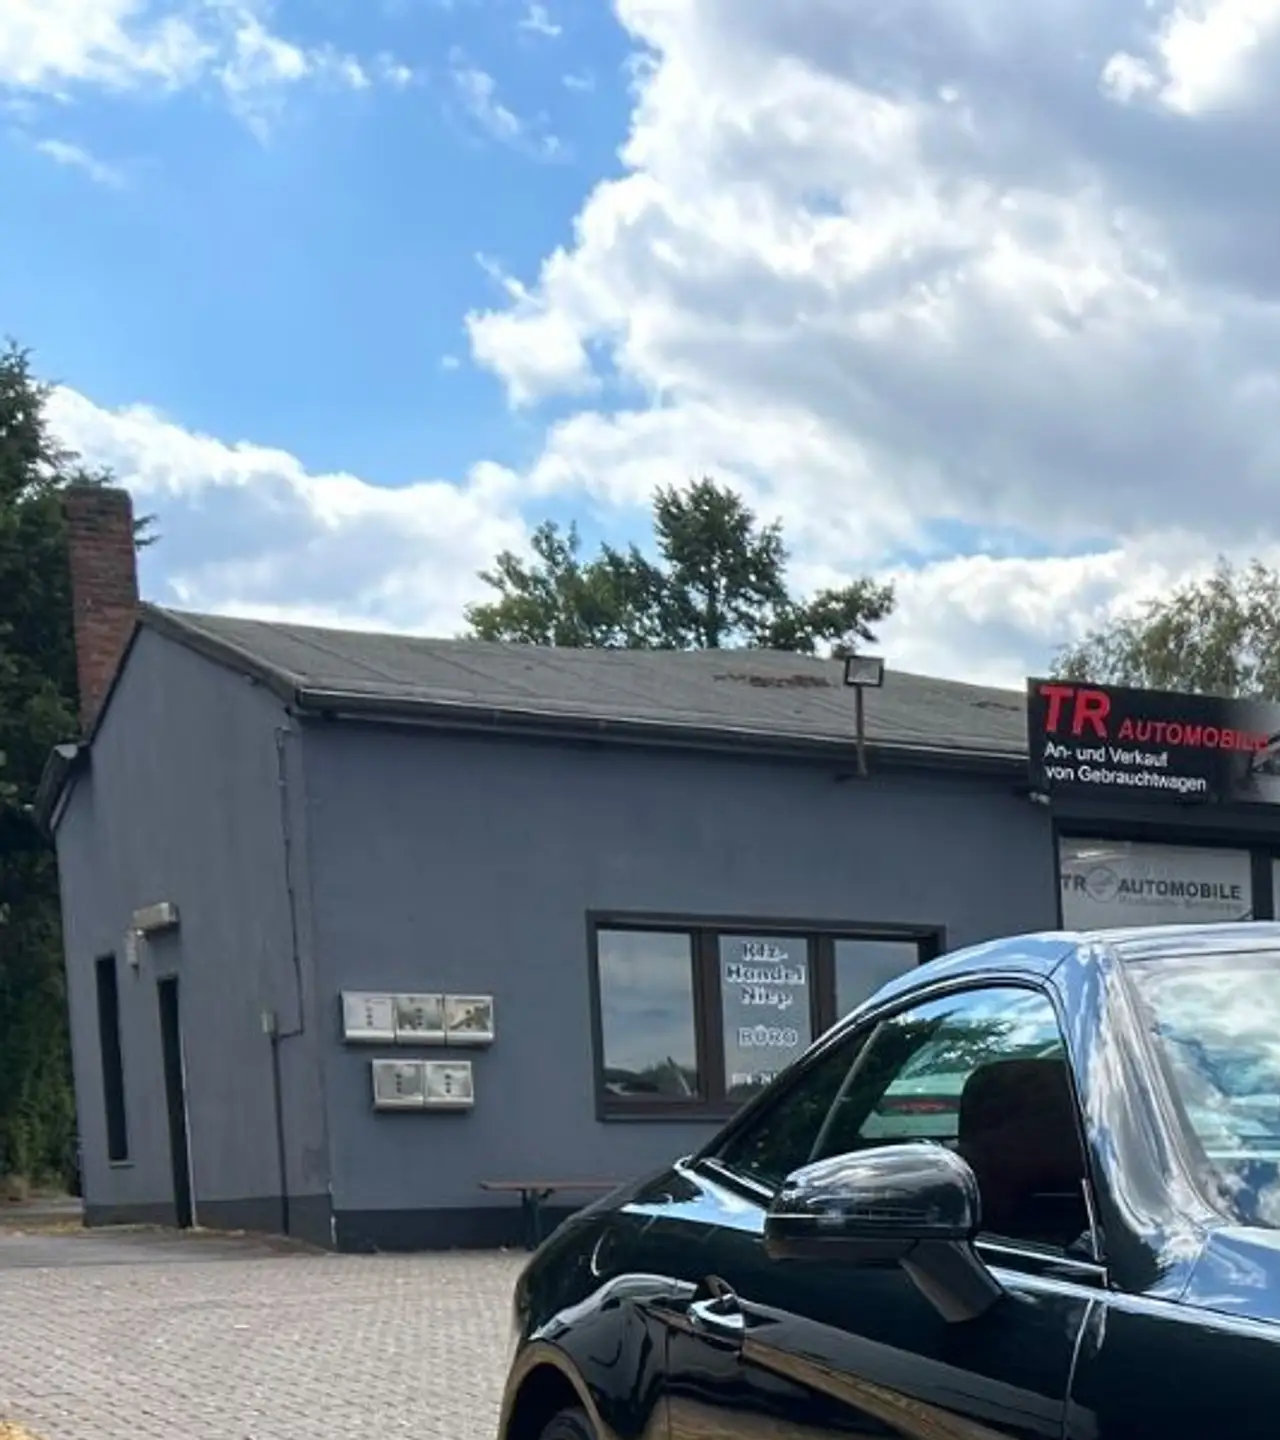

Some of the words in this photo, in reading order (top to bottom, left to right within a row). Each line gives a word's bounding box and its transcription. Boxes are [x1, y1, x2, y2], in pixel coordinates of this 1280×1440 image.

[1040, 684, 1111, 739] TR
[1044, 741, 1073, 759] An-
[1075, 745, 1106, 764] und
[1110, 746, 1169, 768] Verkauf
[1044, 764, 1074, 781] von
[1077, 765, 1207, 793] Gebrauchtwagen
[1061, 873, 1087, 891] TR
[1117, 877, 1242, 901] AUTOMOBILE
